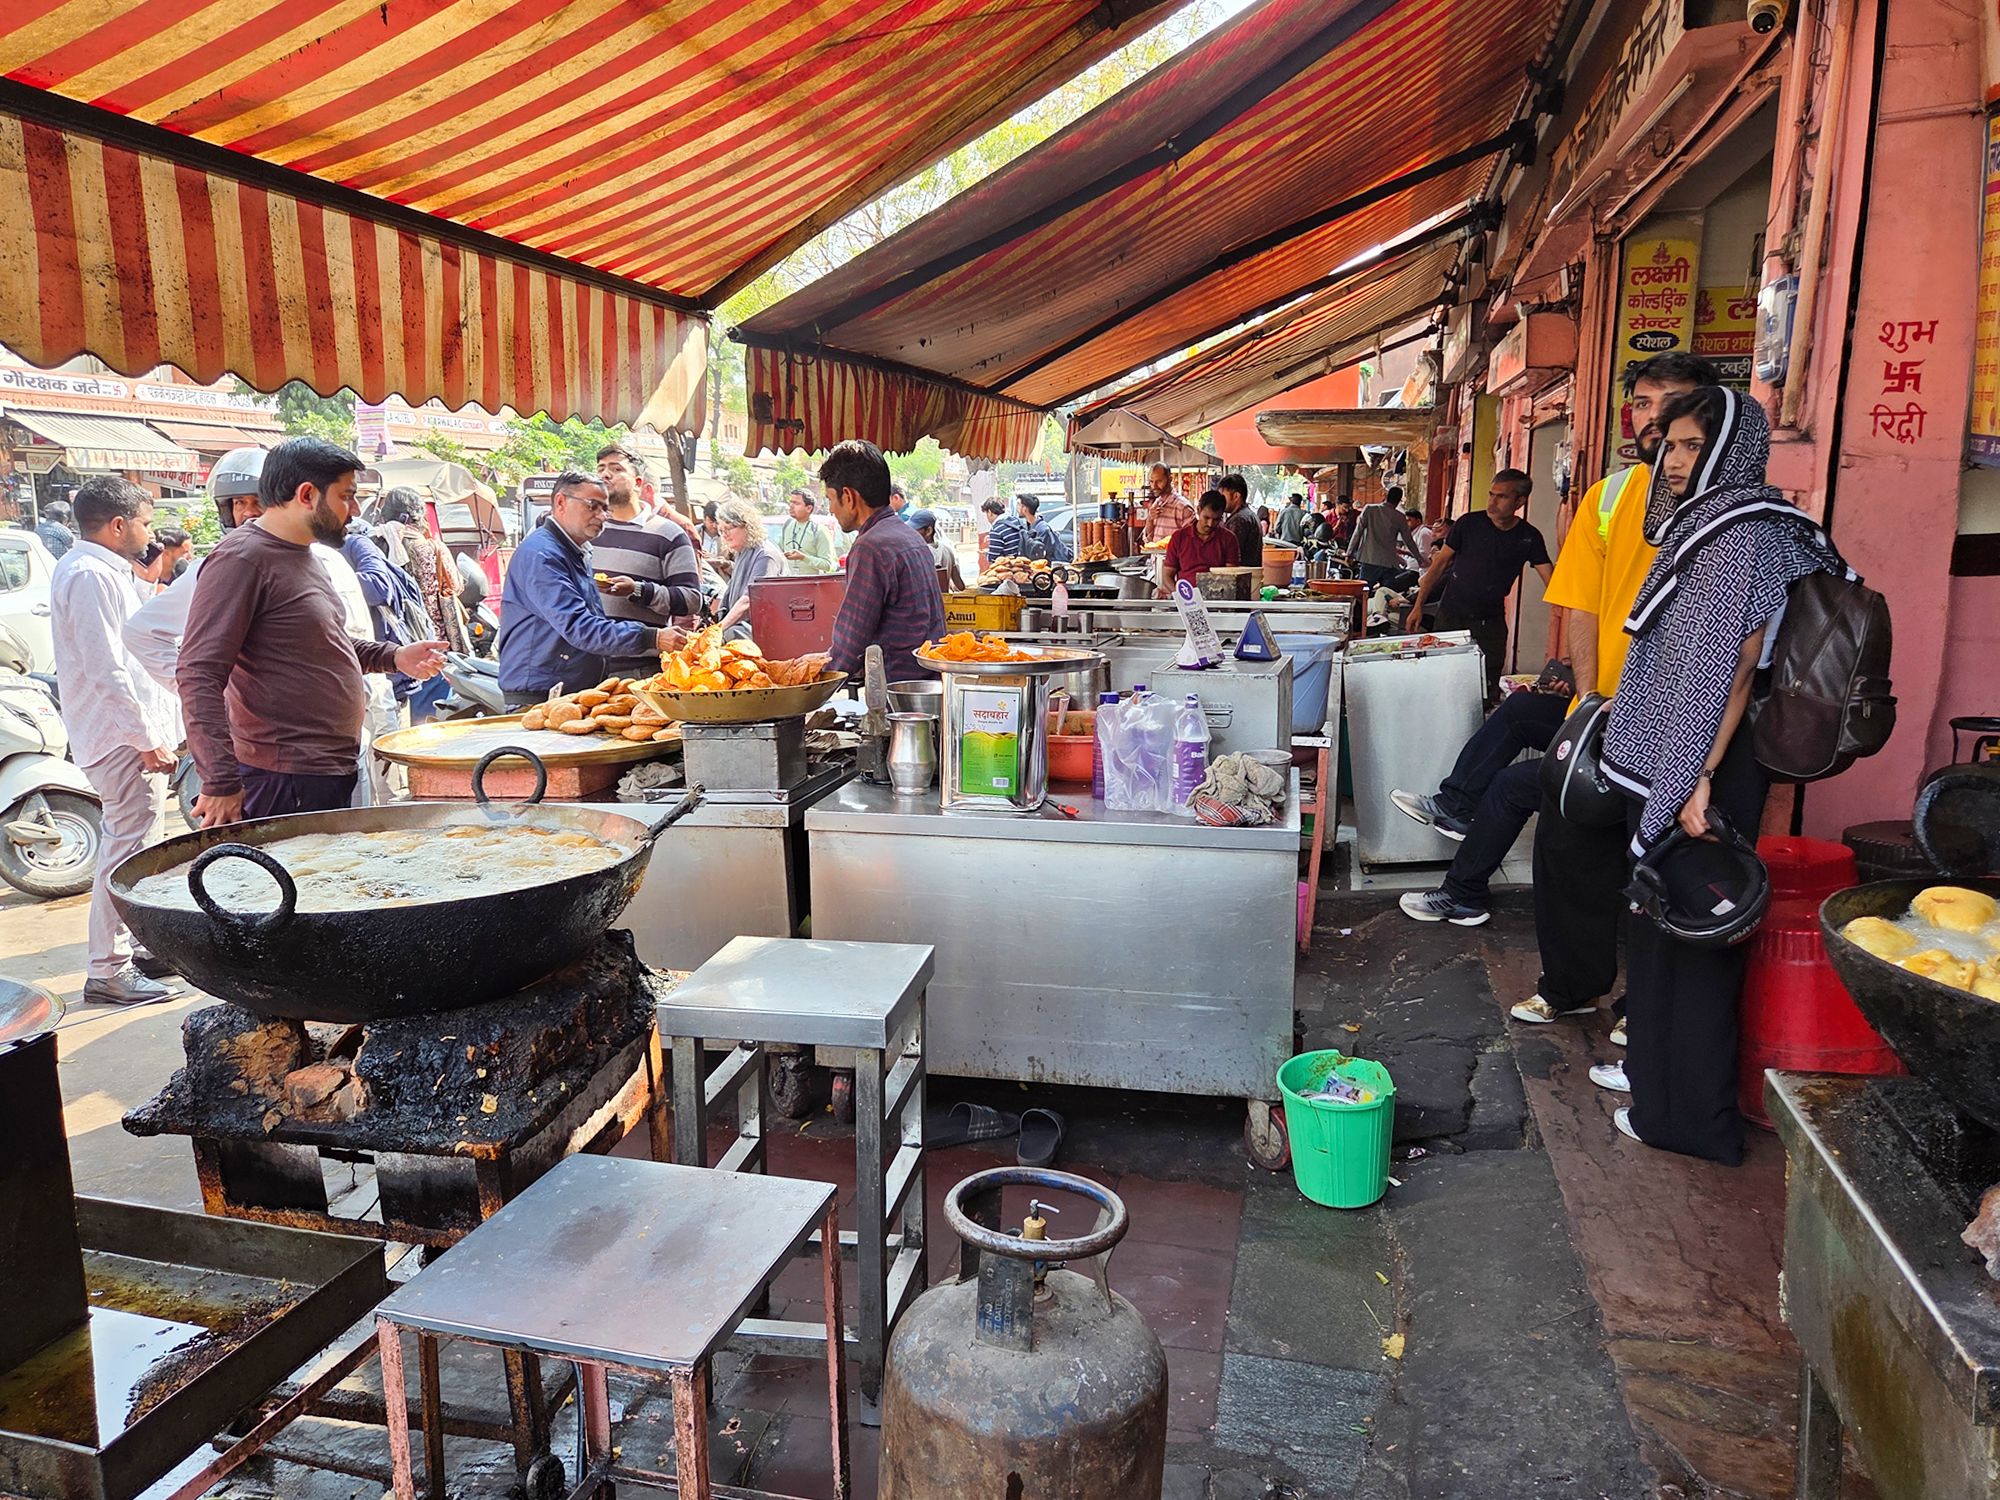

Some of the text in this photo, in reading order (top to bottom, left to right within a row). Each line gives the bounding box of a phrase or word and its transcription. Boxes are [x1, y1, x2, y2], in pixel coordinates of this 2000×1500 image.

[1630, 257, 1690, 285] लक्ष्मी
[1629, 313, 1683, 330] सेन्टर
[1635, 334, 1672, 349] स्पेशल
[1878, 320, 1939, 353] शुभ
[3, 370, 68, 391] गौरक्षक
[73, 379, 100, 395] जूते
[946, 611, 976, 622] Amul
